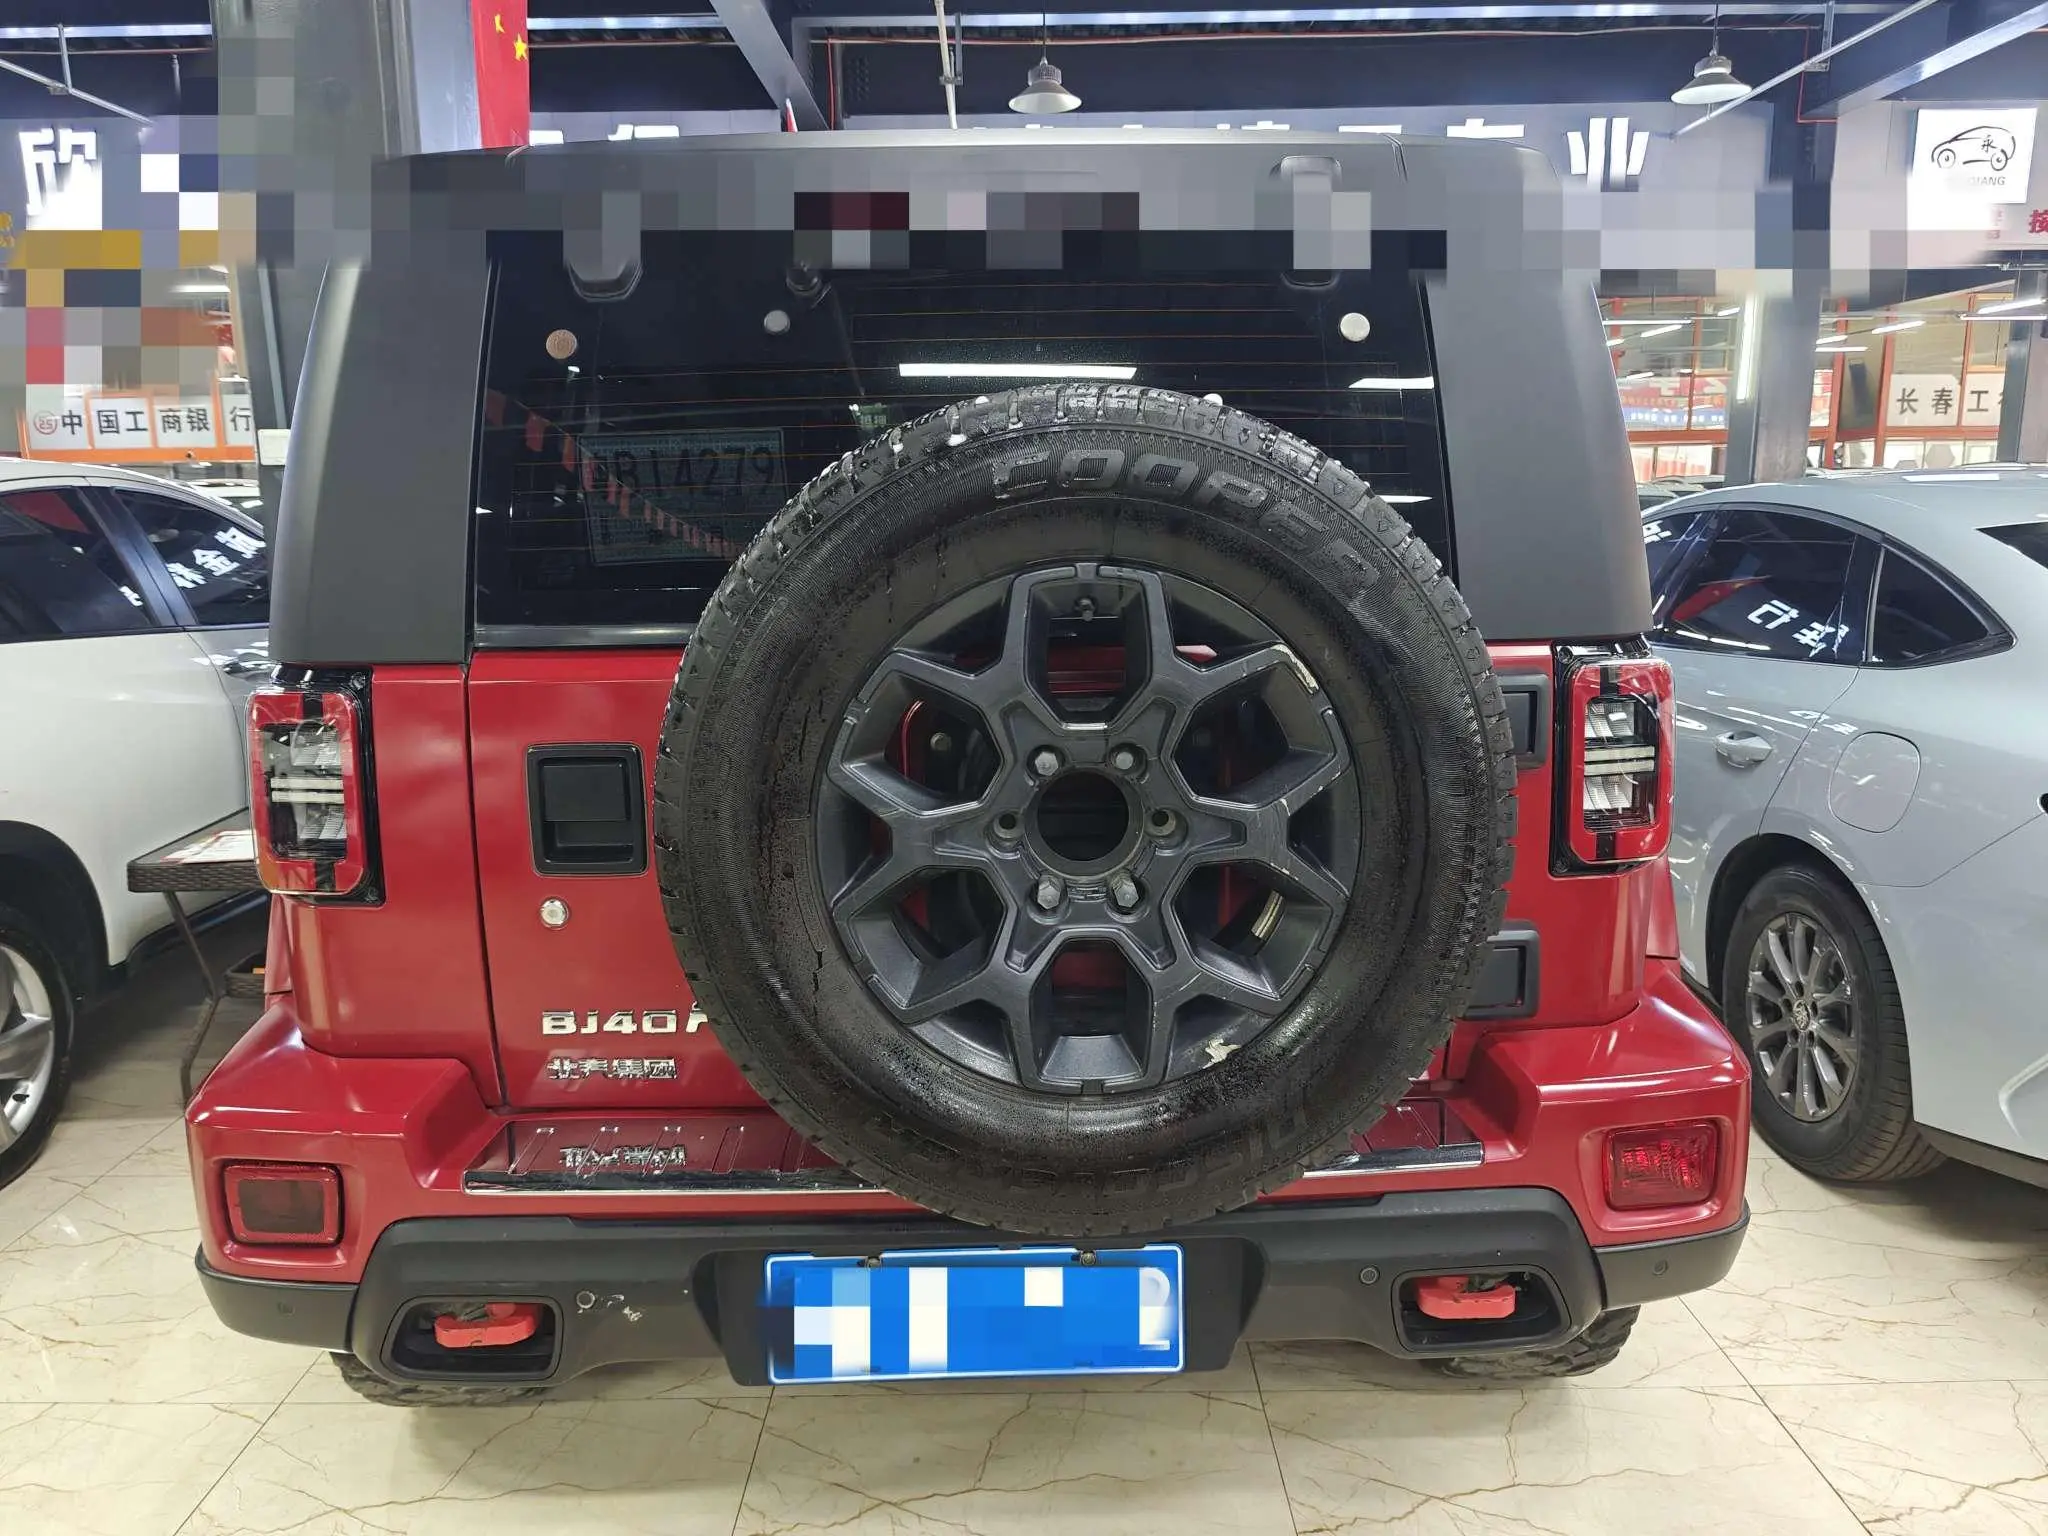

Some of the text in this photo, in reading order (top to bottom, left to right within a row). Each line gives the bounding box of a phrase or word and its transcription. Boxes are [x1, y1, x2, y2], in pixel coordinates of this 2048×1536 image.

[1896, 387, 2003, 415] 长春工
[61, 406, 251, 436] 中国工商银行
[990, 448, 1383, 594] COOPER
